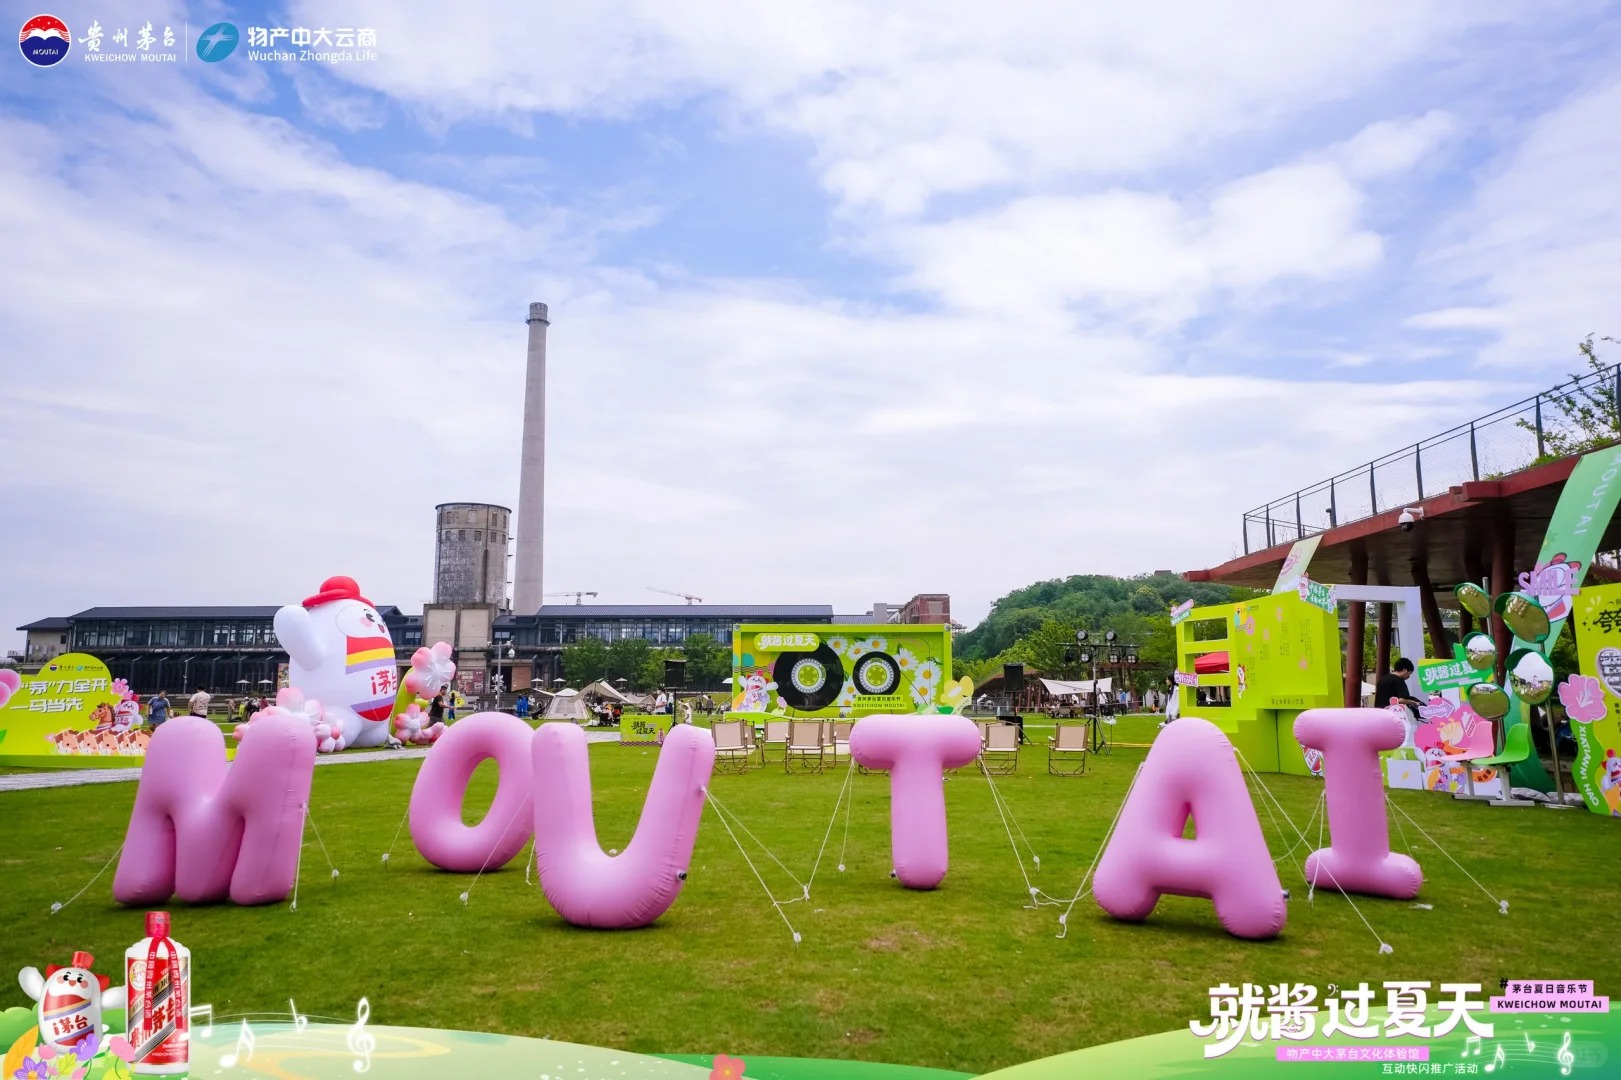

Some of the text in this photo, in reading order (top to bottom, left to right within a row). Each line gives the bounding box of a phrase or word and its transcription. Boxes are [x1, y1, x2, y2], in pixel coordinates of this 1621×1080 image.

[1517, 569, 1580, 597] SMILE
[1422, 660, 1478, 686] 就酱过夏
[10, 697, 83, 713] 一马当先
[1583, 783, 1600, 807] HAO
